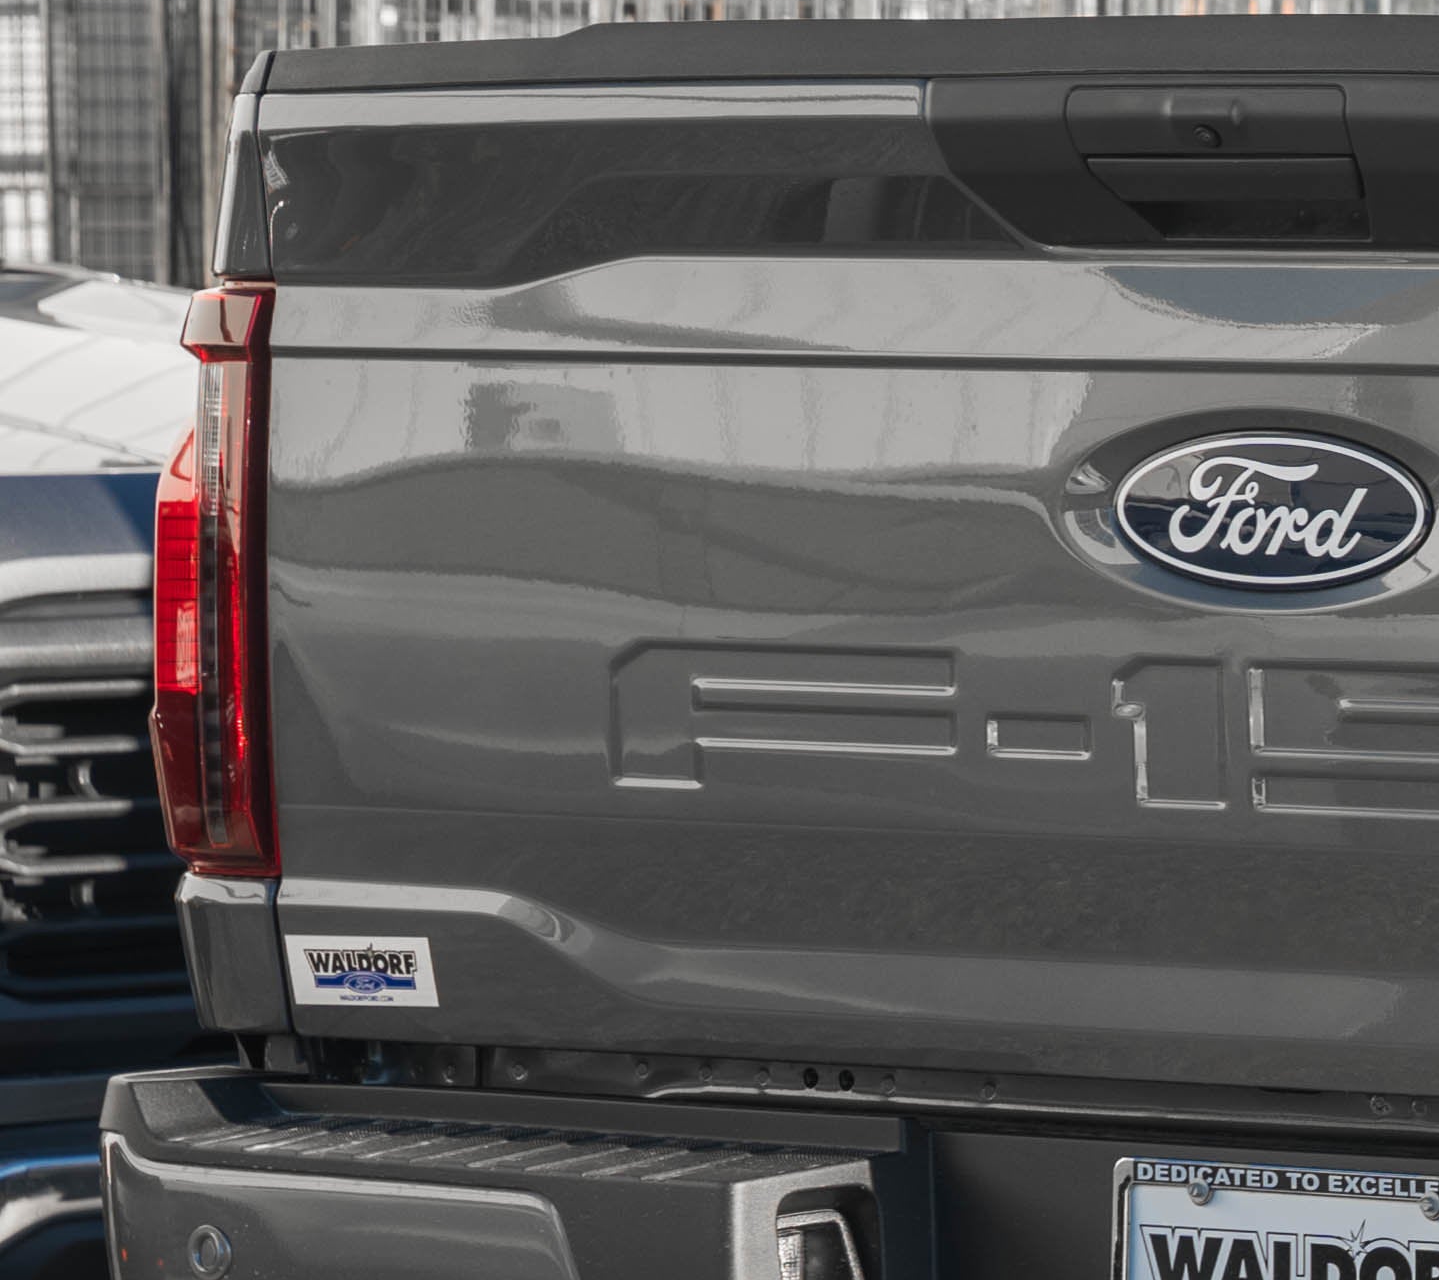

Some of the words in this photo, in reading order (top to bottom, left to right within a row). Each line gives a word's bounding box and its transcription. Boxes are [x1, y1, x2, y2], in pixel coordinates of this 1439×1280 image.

[1168, 455, 1369, 559] Ford
[306, 949, 417, 975] WALDORF
[1136, 1161, 1279, 1191] DEDICATED
[1285, 1171, 1321, 1193] TO
